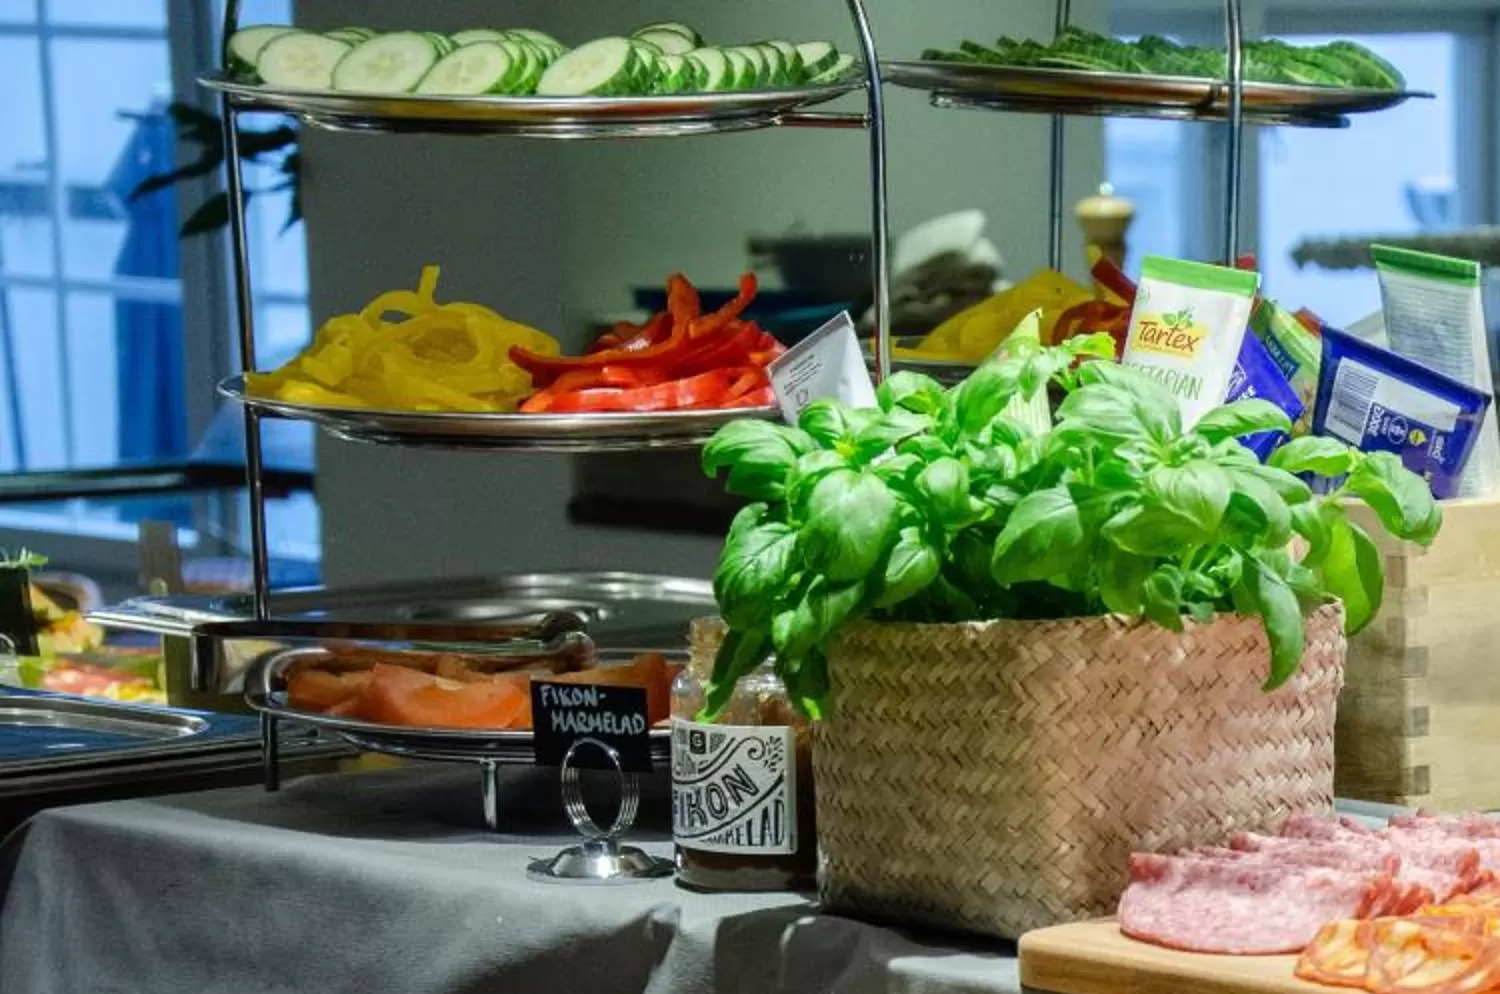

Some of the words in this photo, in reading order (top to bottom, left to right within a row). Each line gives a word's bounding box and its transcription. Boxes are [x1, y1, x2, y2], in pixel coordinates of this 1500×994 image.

[1138, 320, 1202, 352] Tartex
[1125, 361, 1203, 400] TARIAN
[539, 684, 607, 707] FIKON-
[551, 709, 645, 736] MARMELAD
